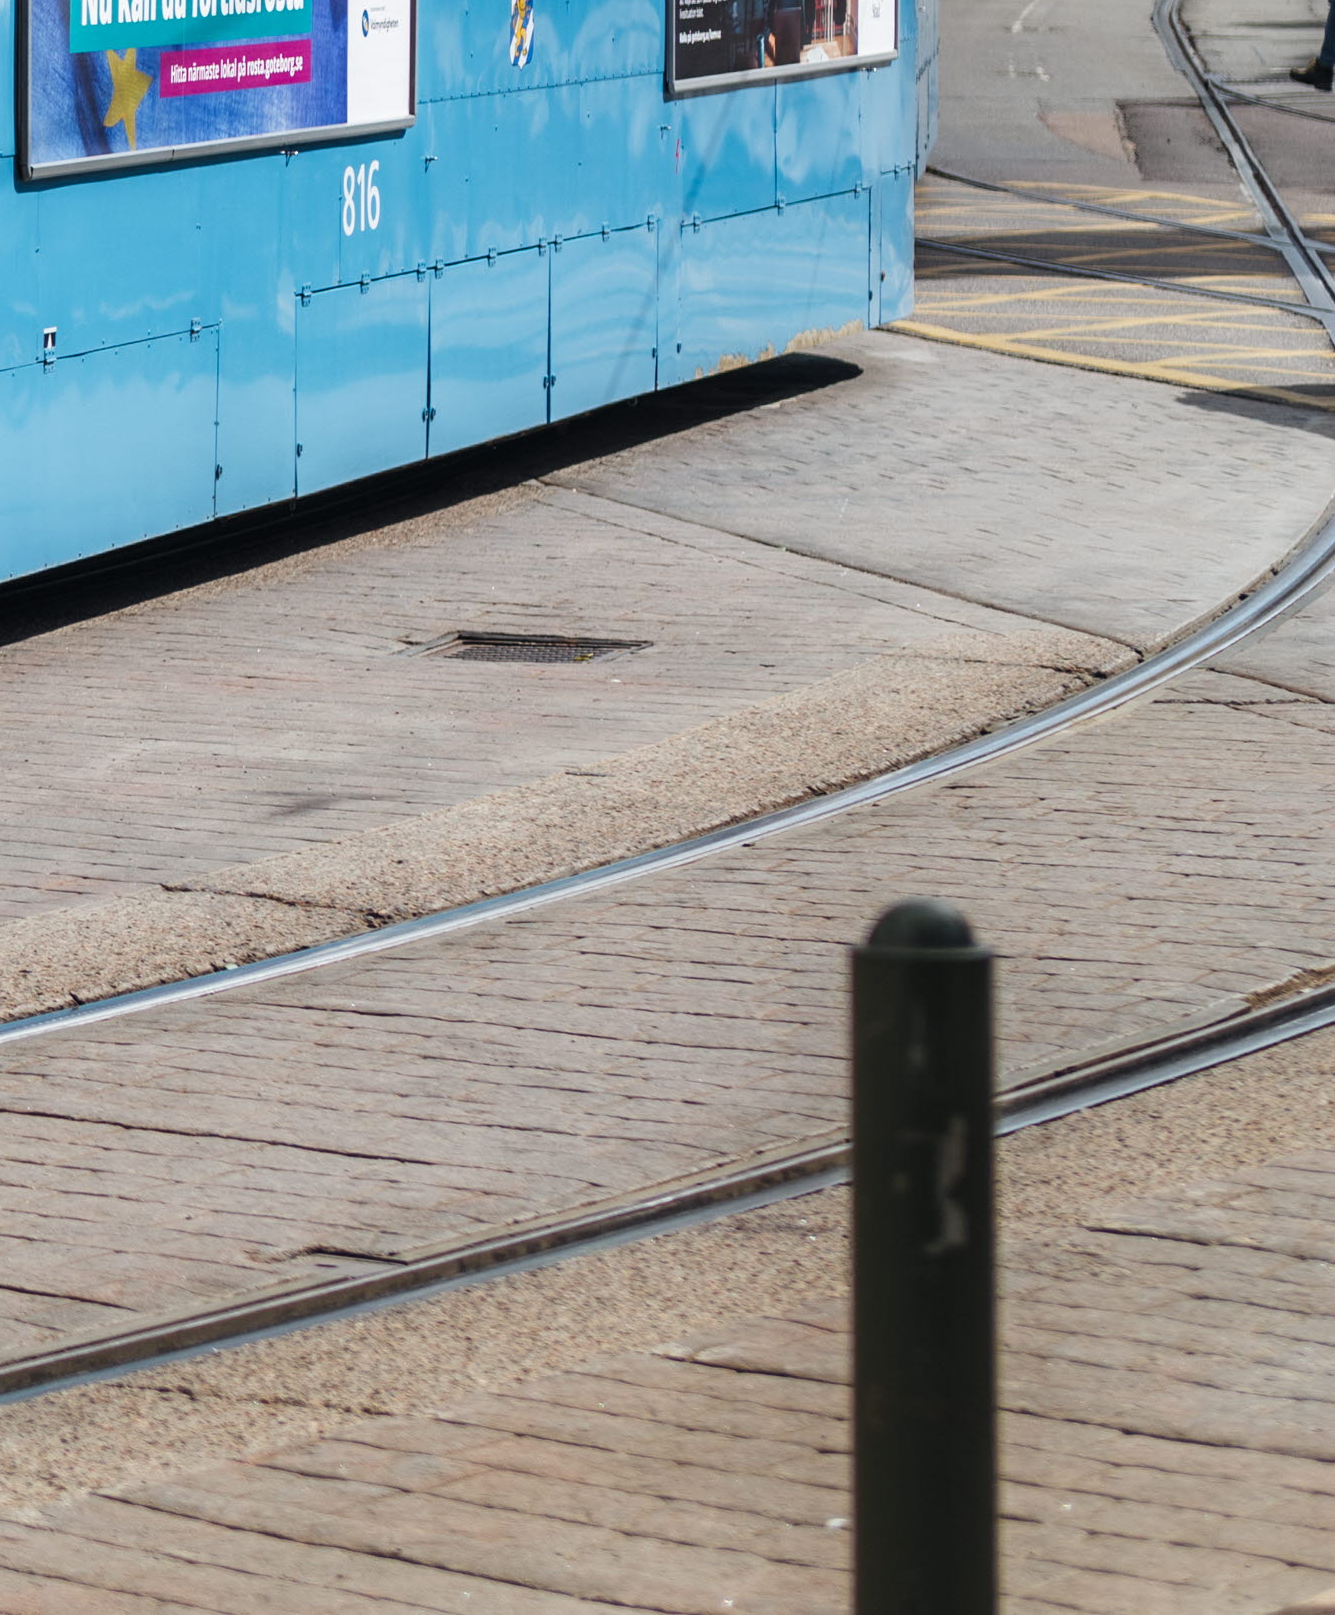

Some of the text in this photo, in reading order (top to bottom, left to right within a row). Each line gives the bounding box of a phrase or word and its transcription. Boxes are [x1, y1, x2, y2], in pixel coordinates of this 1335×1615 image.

[170, 64, 187, 84] Hitta
[188, 61, 220, 82] närmaste
[220, 57, 237, 79] lokal
[237, 55, 246, 83] på
[342, 159, 381, 237] 816
